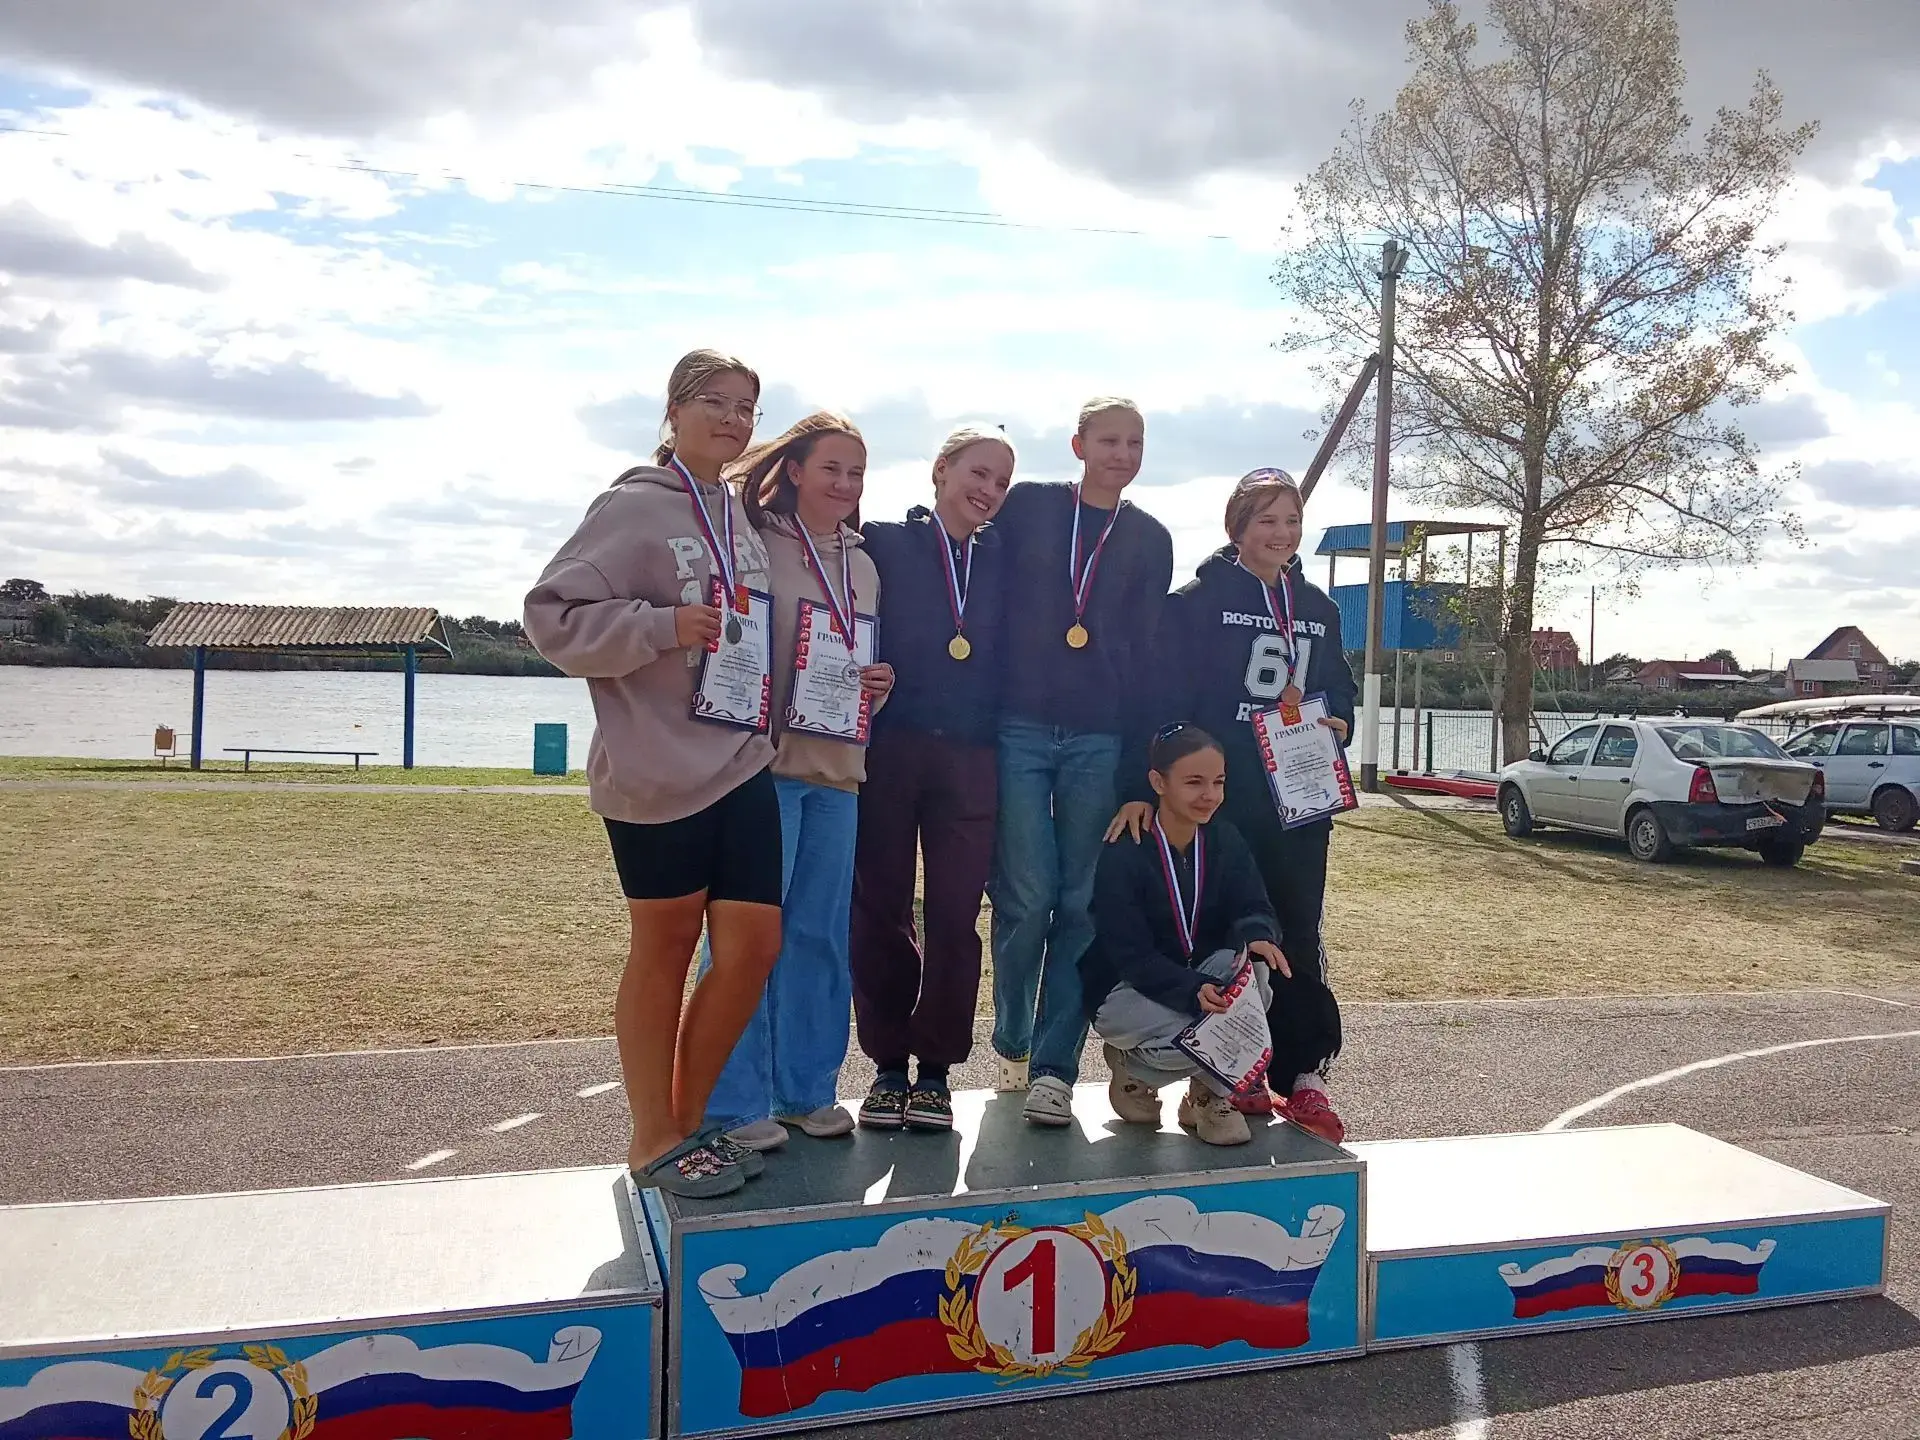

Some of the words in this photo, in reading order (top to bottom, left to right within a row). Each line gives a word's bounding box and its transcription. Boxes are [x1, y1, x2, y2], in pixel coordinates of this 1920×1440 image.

[817, 631, 859, 649] ГРАМА
[1244, 633, 1311, 700] 61
[1274, 722, 1317, 740] ГРАМОТА
[1003, 1239, 1056, 1355] 1
[1631, 1253, 1655, 1297] 3
[195, 1371, 253, 1440] 2
